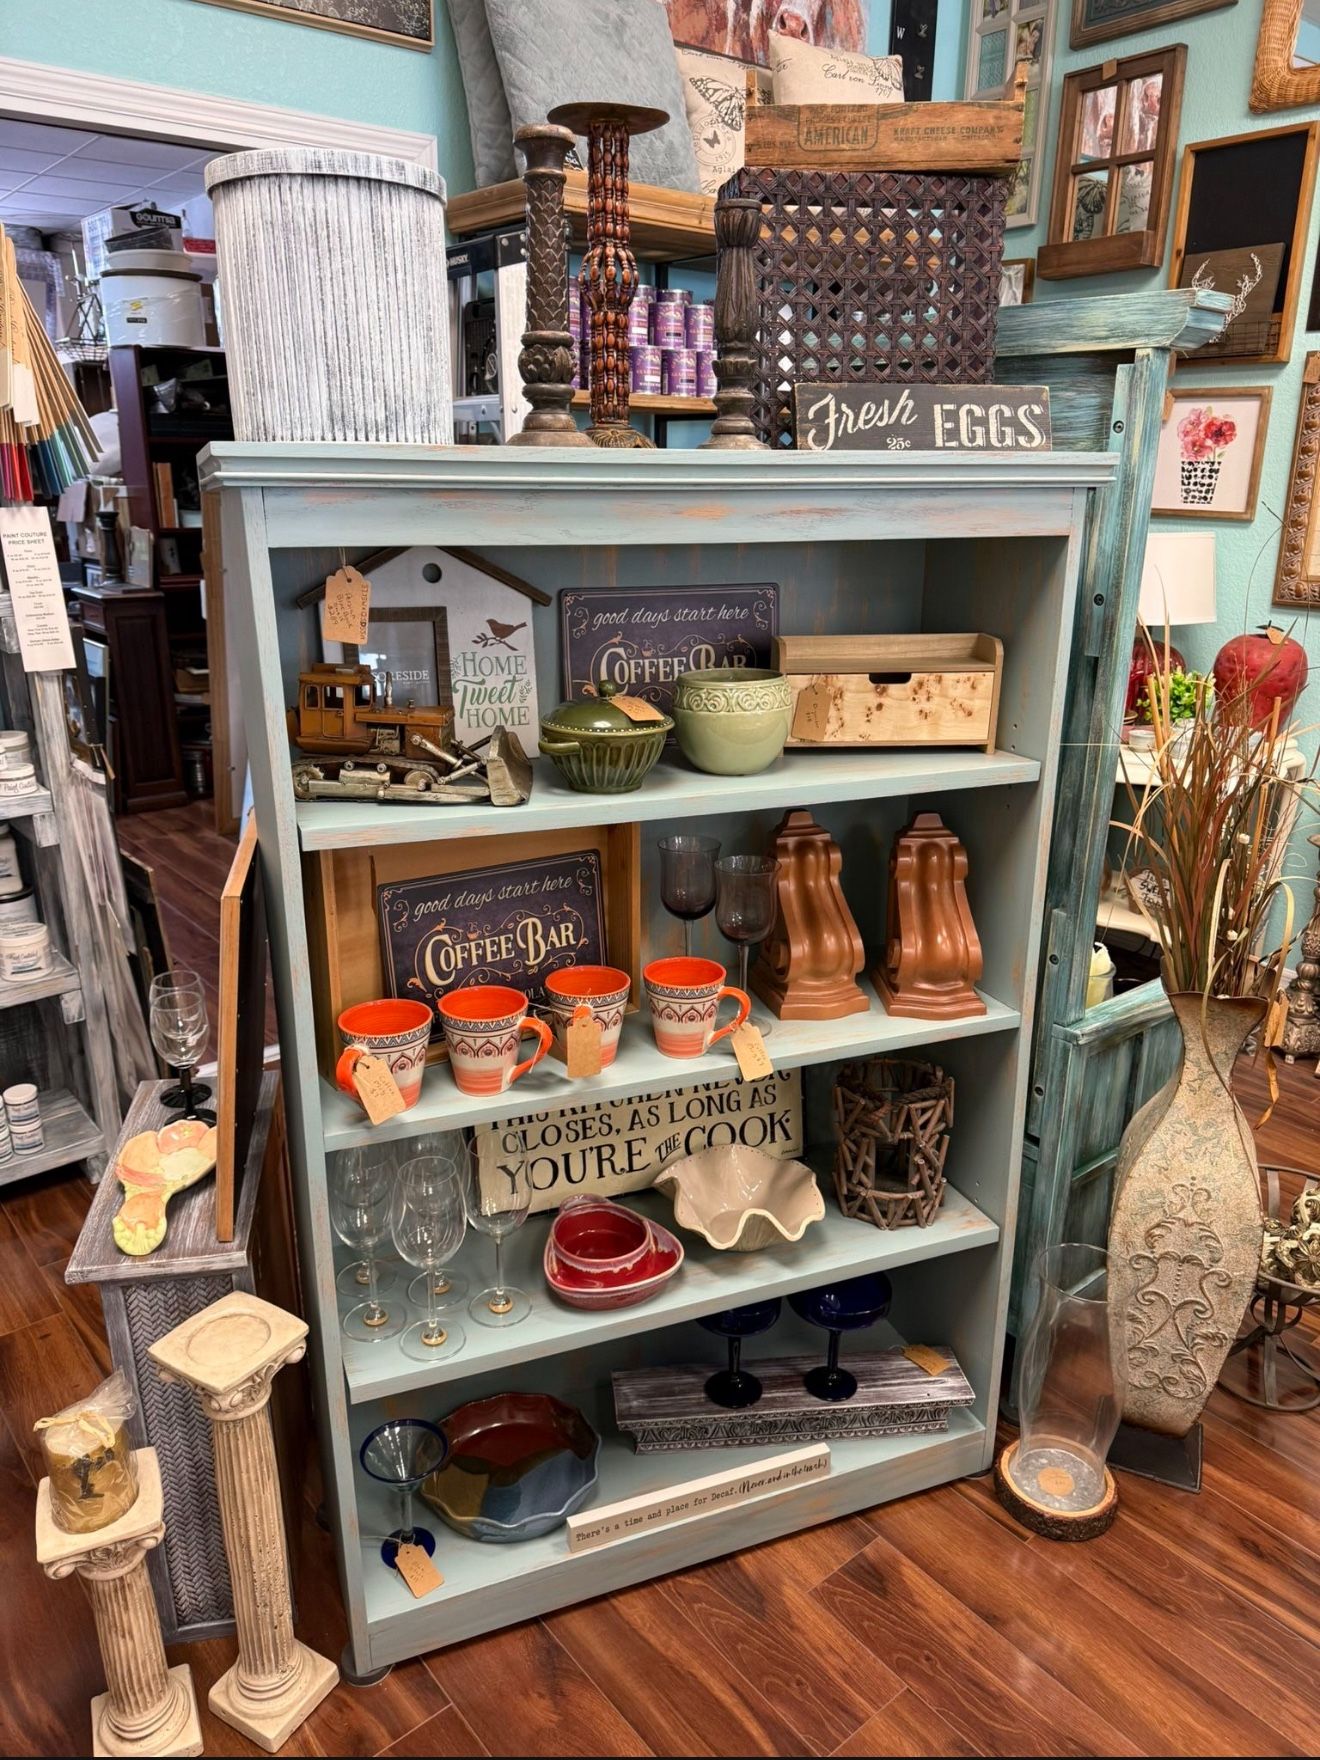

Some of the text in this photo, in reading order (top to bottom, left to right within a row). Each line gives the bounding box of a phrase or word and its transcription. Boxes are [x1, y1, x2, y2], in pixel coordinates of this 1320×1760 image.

[804, 126, 869, 146] AMERICAN
[924, 127, 956, 135] CHEESE
[808, 389, 1047, 450] Fresh EGGS
[592, 604, 749, 631] good days start here
[372, 670, 430, 681] ORESIDE
[460, 652, 528, 677] HOME
[452, 675, 524, 719] Tweet
[466, 706, 530, 729] HOME
[413, 875, 573, 921] good days start here
[516, 916, 578, 966] BAR
[502, 1113, 621, 1154] CLOSES,
[628, 1104, 661, 1132] AS
[669, 1089, 742, 1124] LONG
[748, 1083, 777, 1109] AS
[498, 1109, 793, 1196] YOU'RE THE COOK
[576, 1525, 610, 1542] There's
[624, 1515, 643, 1527] time
[647, 1509, 662, 1520] and
[666, 1502, 690, 1516] place
[693, 1496, 708, 1506] for
[711, 1486, 738, 1501] Decaf.
[767, 1469, 782, 1483] and
[791, 1465, 803, 1476] the
